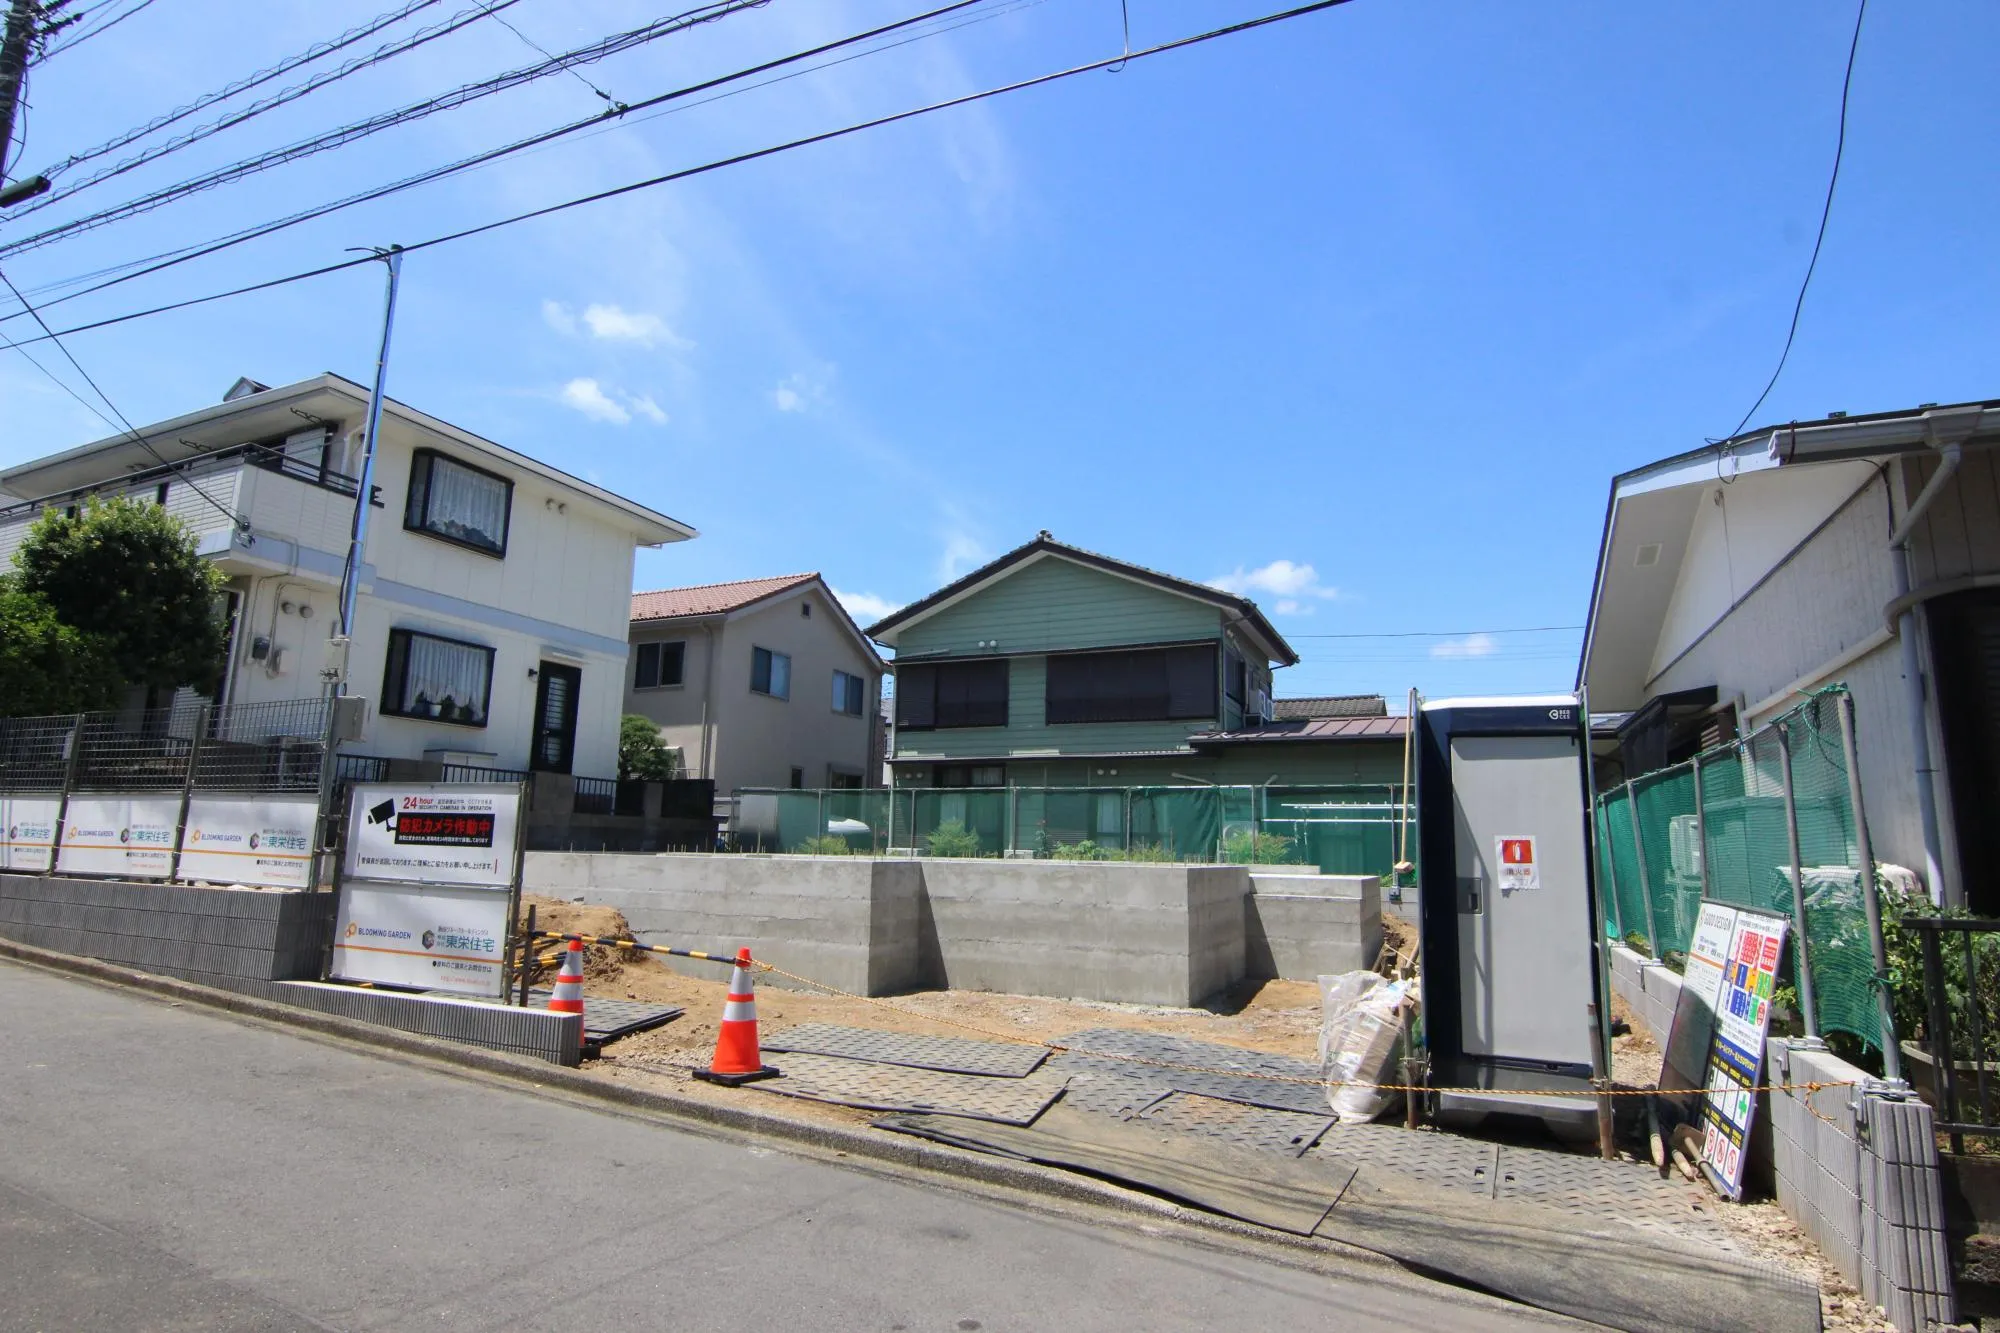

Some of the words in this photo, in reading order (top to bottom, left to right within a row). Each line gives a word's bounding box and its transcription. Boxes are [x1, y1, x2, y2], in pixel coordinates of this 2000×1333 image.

[403, 796, 417, 809] 24
[400, 818, 490, 836] 防犯カメラ作動中
[268, 836, 307, 850] 東栄住宅
[358, 928, 387, 938] BLOOMING
[387, 930, 412, 940] GARDEN
[446, 935, 495, 953] 東栄住宅
